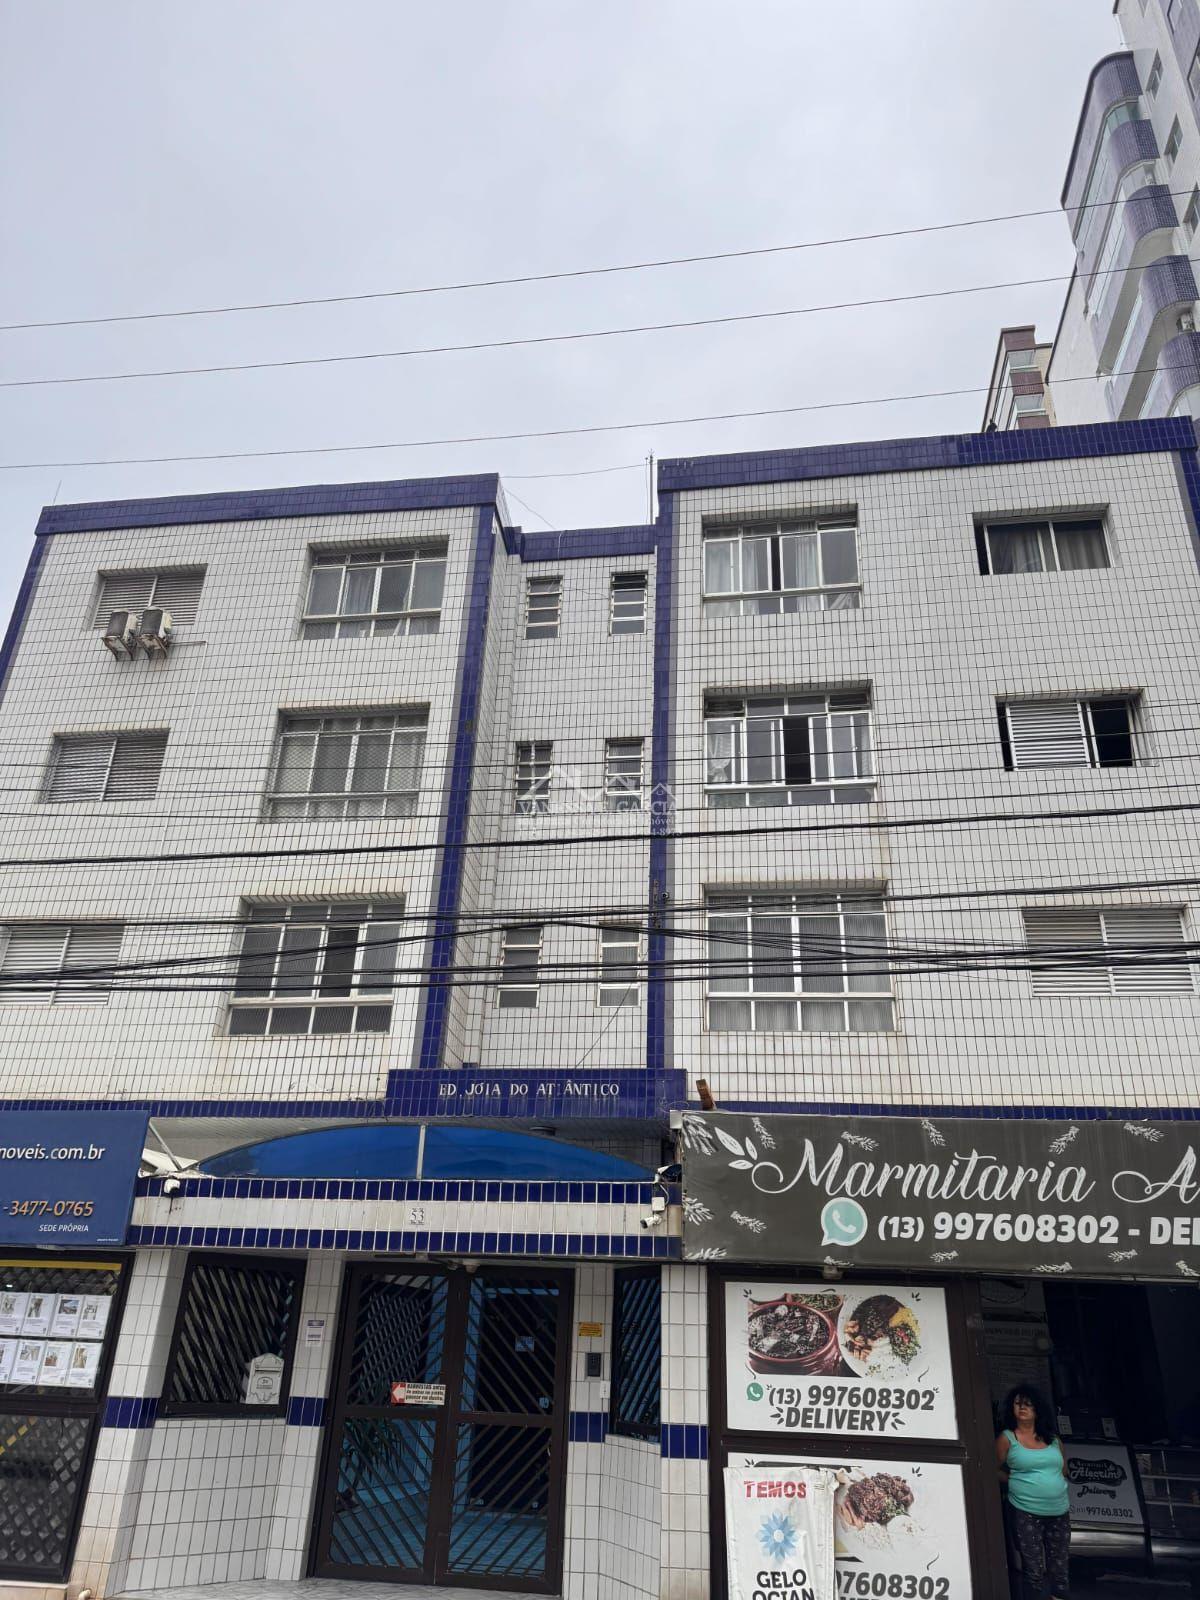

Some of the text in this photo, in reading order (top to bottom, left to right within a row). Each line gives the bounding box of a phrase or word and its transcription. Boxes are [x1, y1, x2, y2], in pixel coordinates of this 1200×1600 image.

[510, 1083, 529, 1096] DO
[536, 1079, 620, 1097] ATÂNTICO
[751, 1138, 1096, 1203] Marmitaria
[38, 1222, 89, 1232] SEDE PRÓPRIA
[877, 1215, 925, 1242] (13)
[934, 1211, 1119, 1244] 997608302
[768, 1385, 935, 1410] (13) 997608302
[785, 1407, 891, 1432] DELIVERY
[744, 1480, 807, 1499] TEMOS
[756, 1569, 807, 1588] GELO
